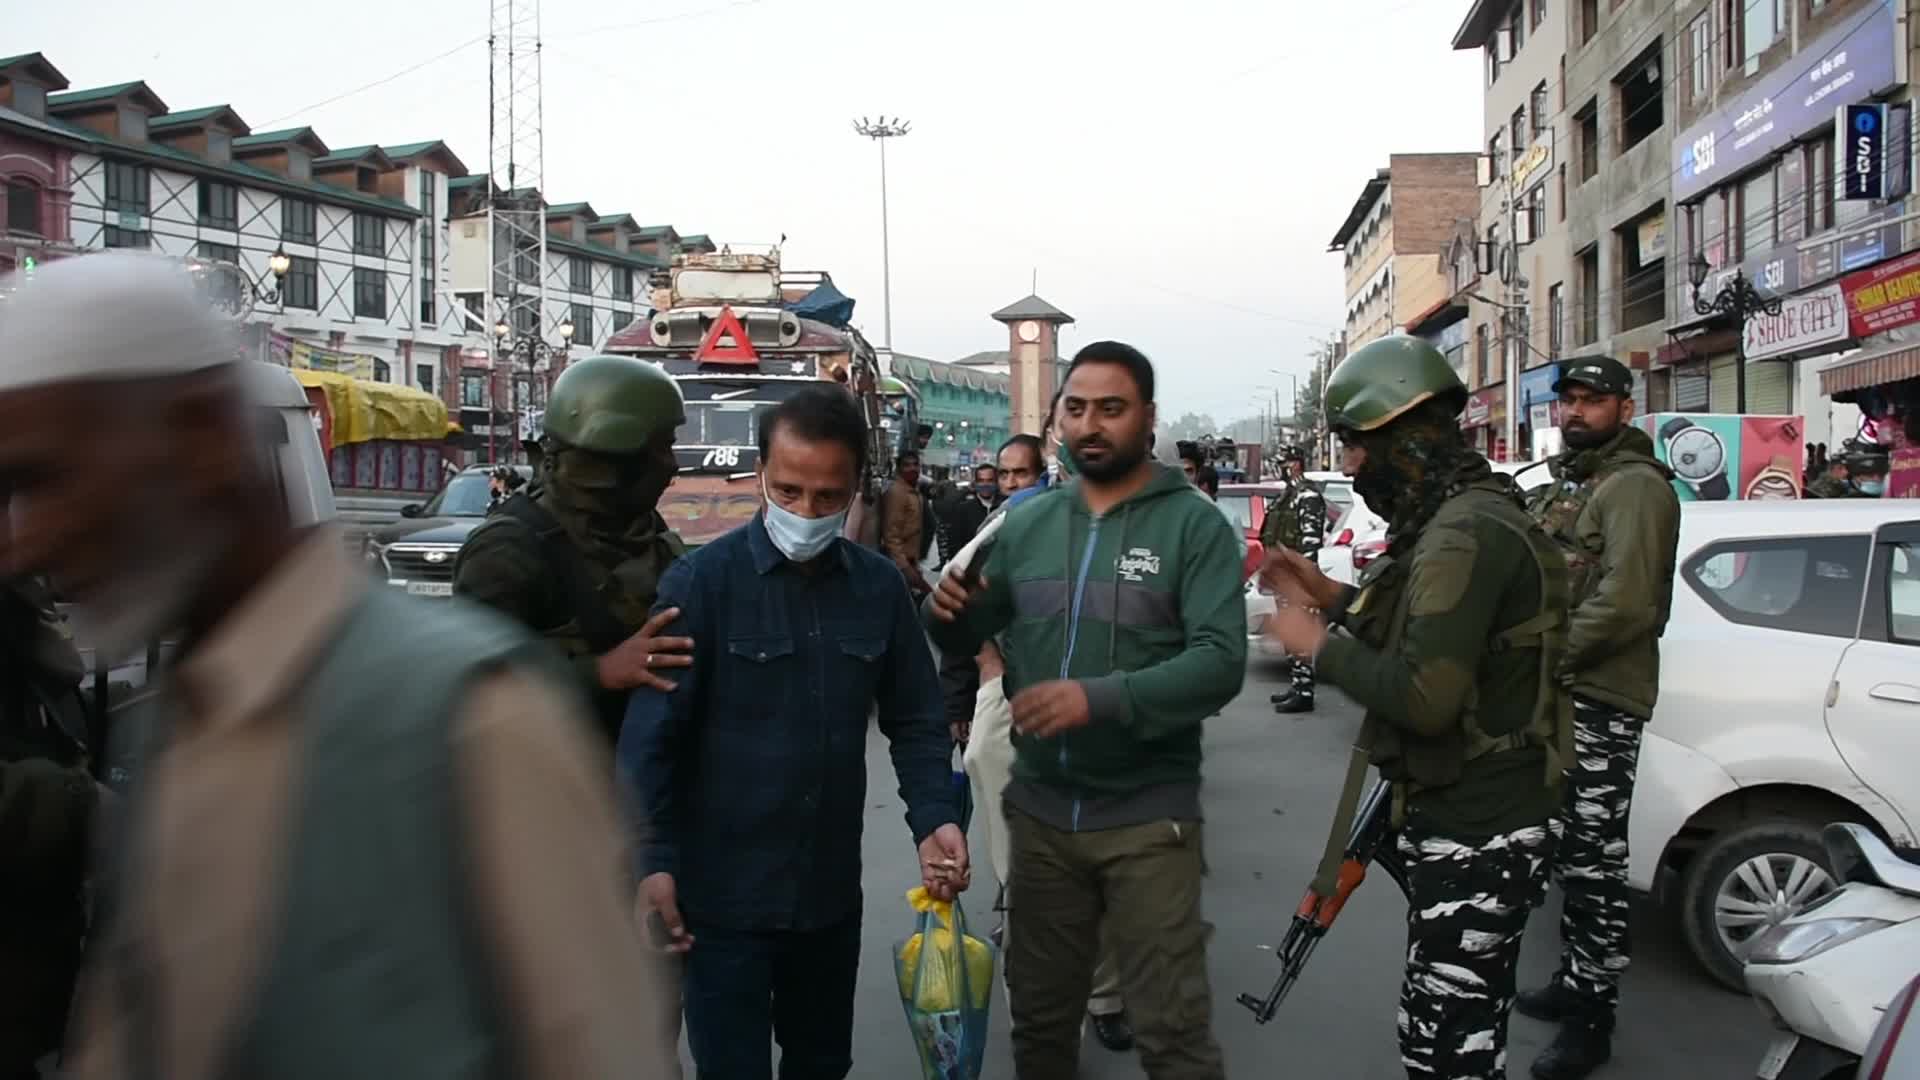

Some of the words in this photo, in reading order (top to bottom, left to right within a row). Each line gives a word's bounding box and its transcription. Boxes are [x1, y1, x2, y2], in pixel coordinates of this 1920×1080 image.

[1693, 131, 1715, 175] SBI
[1857, 136, 1871, 193] SBI
[1764, 259, 1784, 289] SBI
[1758, 307, 1796, 346] SHOE
[1800, 294, 1837, 336] CITY
[703, 448, 739, 466] 786
